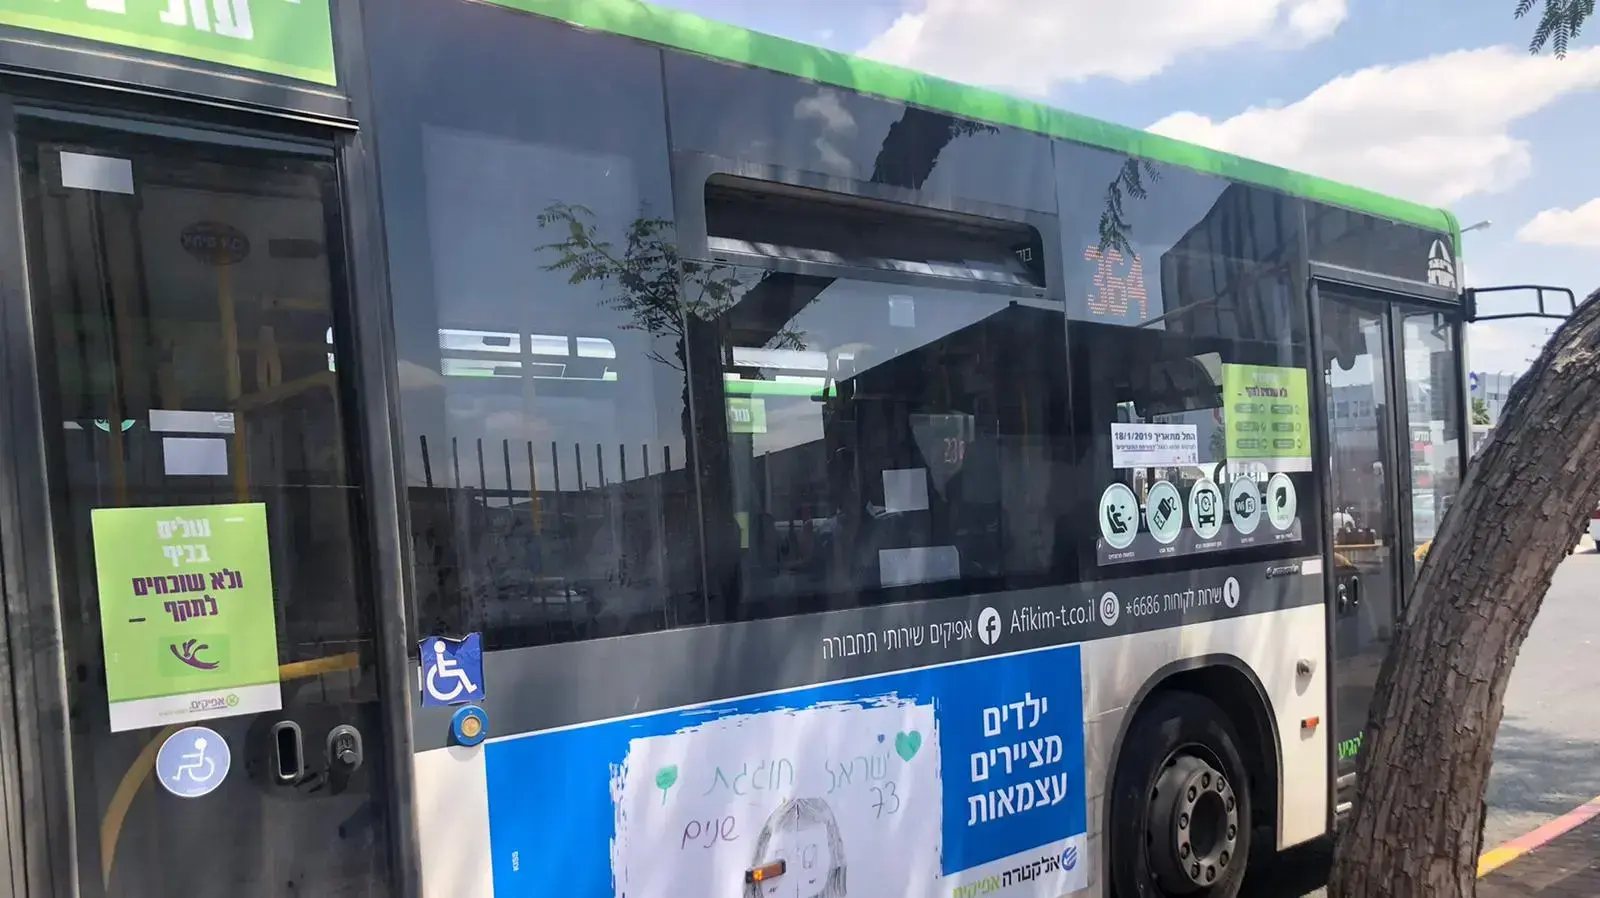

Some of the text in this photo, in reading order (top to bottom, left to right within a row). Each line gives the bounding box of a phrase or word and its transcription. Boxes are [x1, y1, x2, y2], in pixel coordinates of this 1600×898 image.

[1084, 244, 1147, 319] 36A
[1114, 431, 1196, 442] החל מתאריך 18/1/2019
[162, 544, 211, 567] בכיף
[132, 568, 243, 596] ולא שוכחים
[1198, 586, 1222, 608] שירות
[163, 594, 219, 622] לתקף
[1010, 599, 1096, 634] Afikim-t.co.il
[1163, 588, 1195, 614] לקוחות
[822, 619, 973, 659] אפיקים שירותי תחבורה
[191, 697, 225, 710] אפיקים
[983, 691, 1048, 737] ילדים
[702, 752, 891, 796] ישראל חוגגת
[970, 735, 1063, 782] מציירים
[869, 781, 900, 820] 73
[967, 772, 1068, 826] עצמאות
[681, 815, 740, 850] שנים
[1002, 854, 1061, 888] אלקטרה
